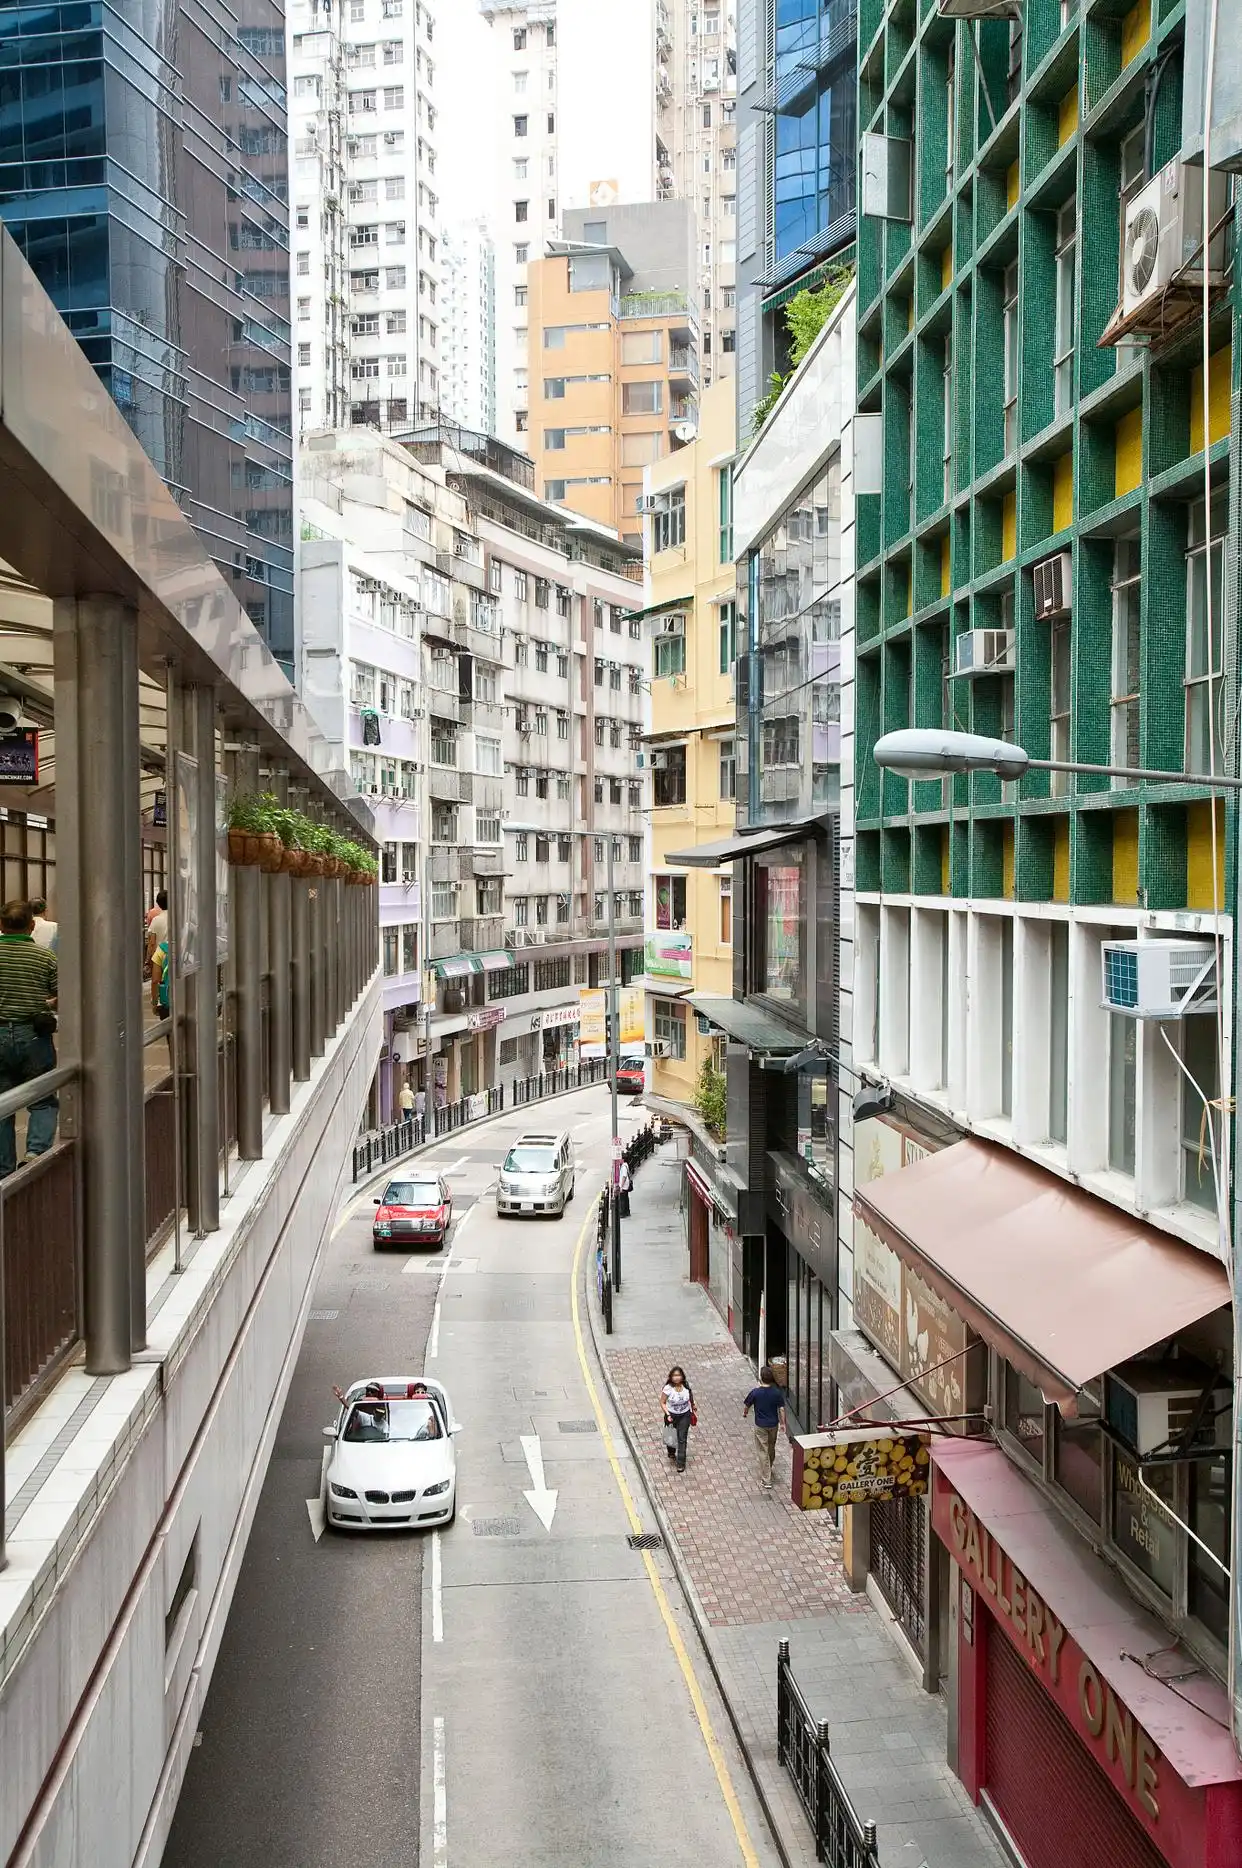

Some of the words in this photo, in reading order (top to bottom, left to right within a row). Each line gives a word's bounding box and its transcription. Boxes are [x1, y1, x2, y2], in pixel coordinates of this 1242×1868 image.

[840, 1479, 875, 1491] GALLERY
[876, 1477, 894, 1486] ONE
[1140, 1502, 1149, 1528] &
[1130, 1515, 1160, 1561] Retail
[949, 1494, 1068, 1685] GALLERY
[1078, 1660, 1161, 1820] ONE
